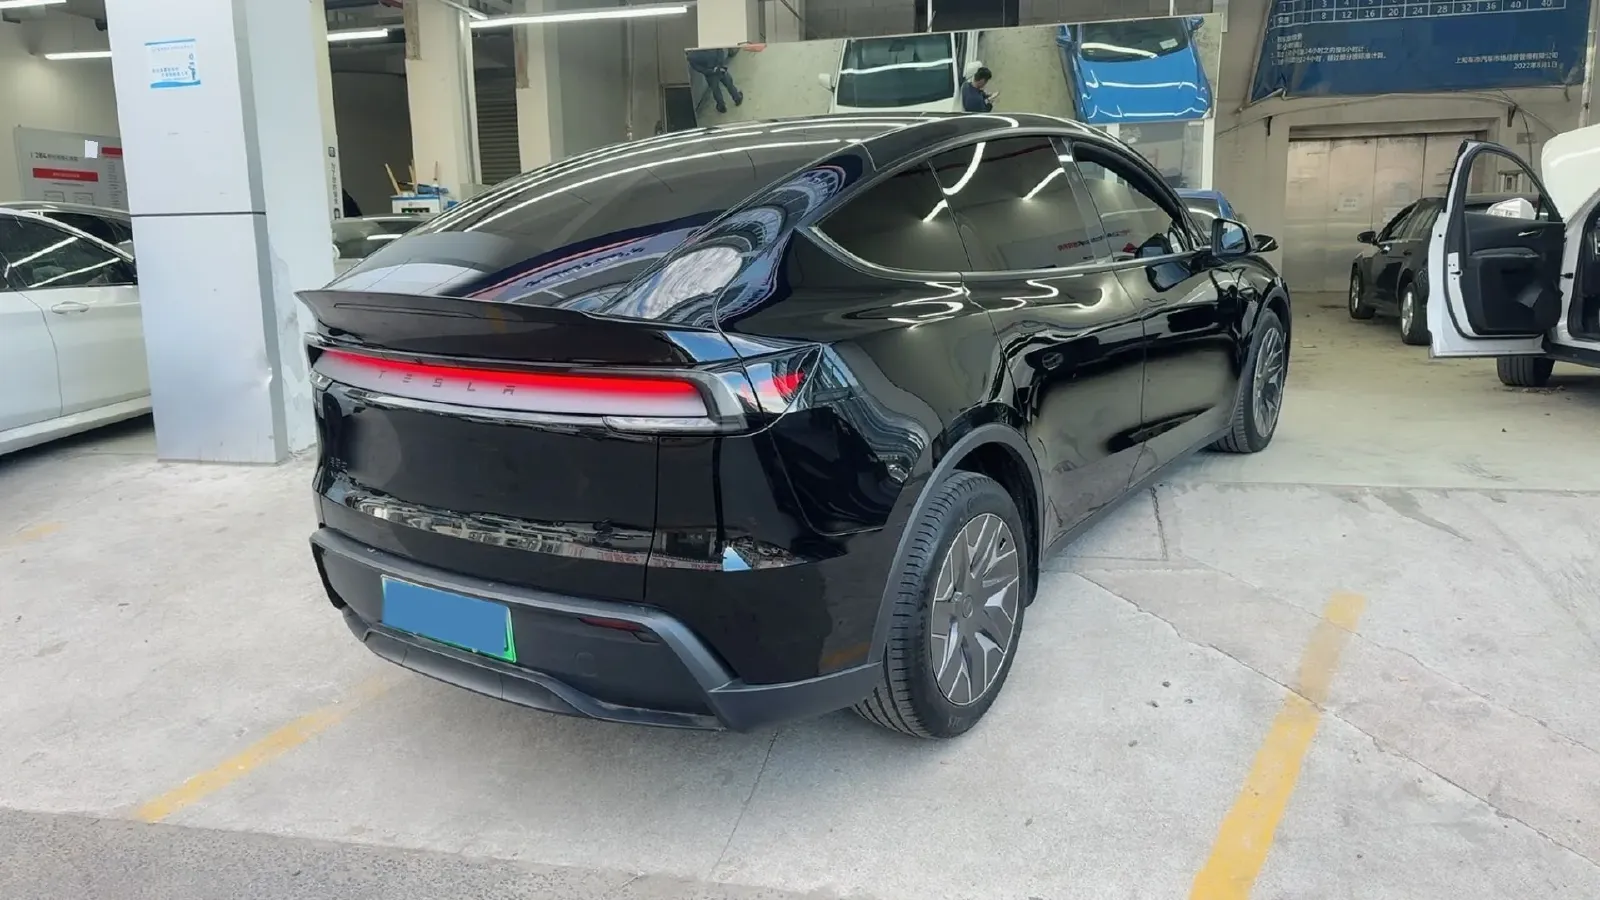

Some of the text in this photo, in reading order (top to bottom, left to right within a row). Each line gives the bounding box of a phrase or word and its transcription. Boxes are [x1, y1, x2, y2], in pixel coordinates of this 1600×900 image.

[1320, 11, 1327, 20] 8
[1341, 11, 1353, 19] 12
[1364, 10, 1376, 18] 16
[1387, 8, 1399, 17] 20
[1412, 7, 1424, 15] 24
[1436, 5, 1448, 14] 28
[1461, 3, 1472, 12] 32
[1485, 2, 1497, 11] 36
[1510, 1, 1522, 9] 40
[378, 370, 516, 396] TESLA
